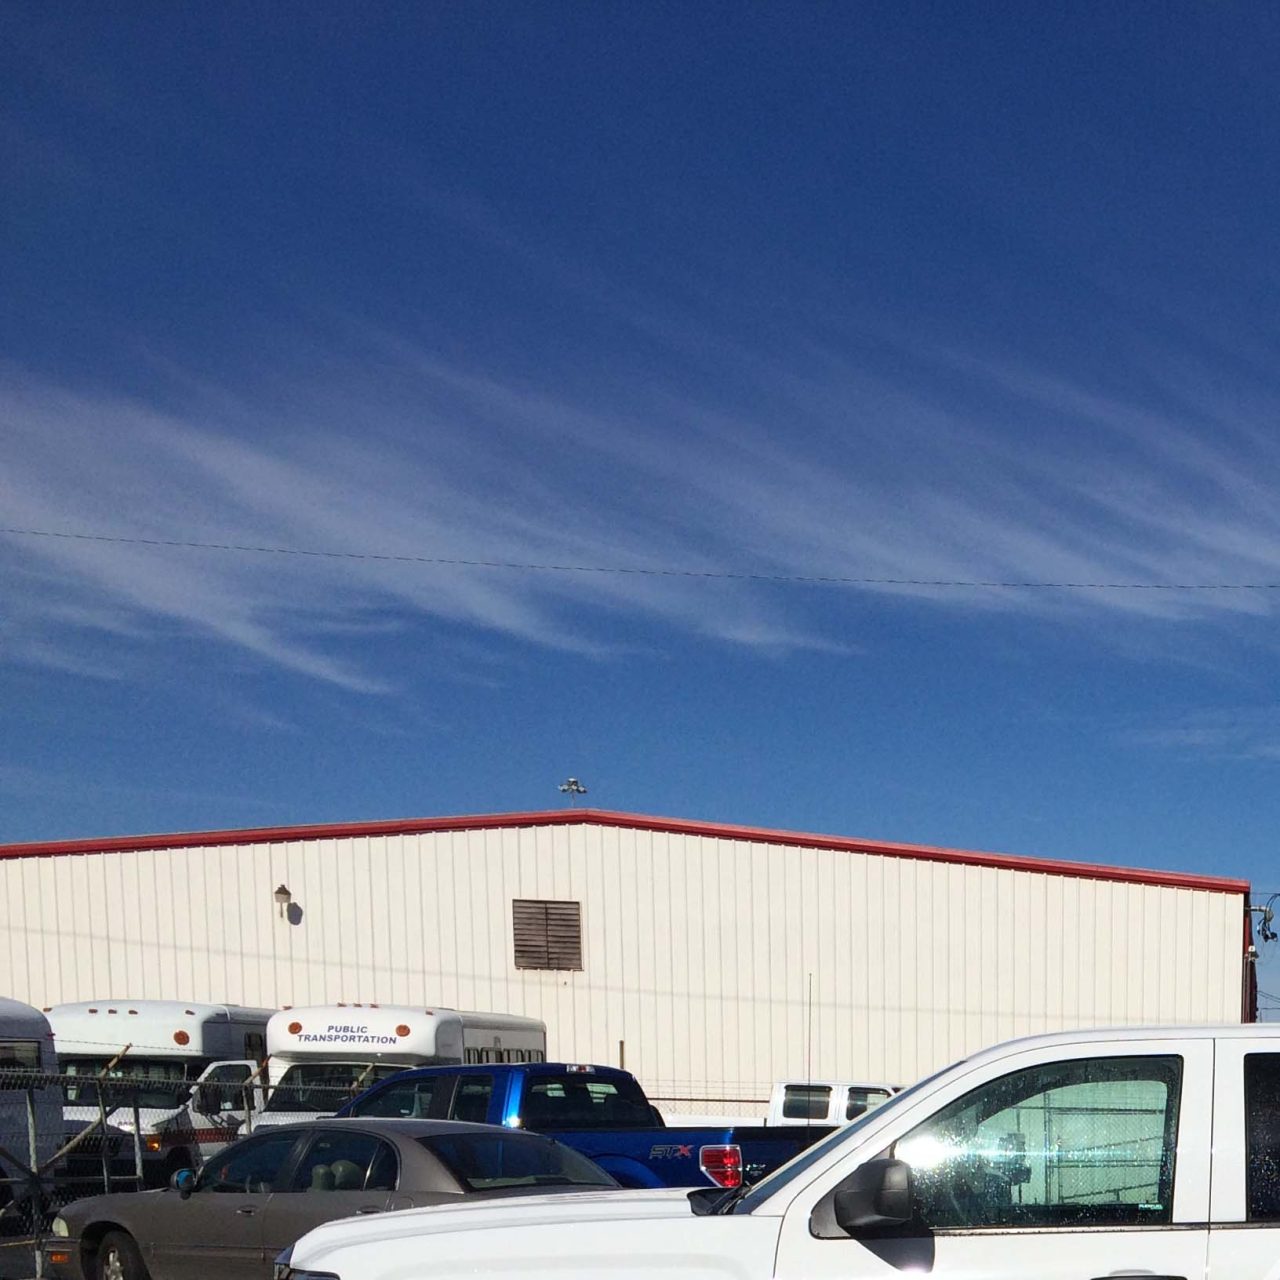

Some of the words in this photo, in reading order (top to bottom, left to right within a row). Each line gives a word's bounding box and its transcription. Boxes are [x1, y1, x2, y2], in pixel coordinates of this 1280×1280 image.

[327, 1025, 368, 1034] PUBLIC
[297, 1034, 397, 1045] TRANSPORTATION
[648, 1144, 694, 1160] STX
